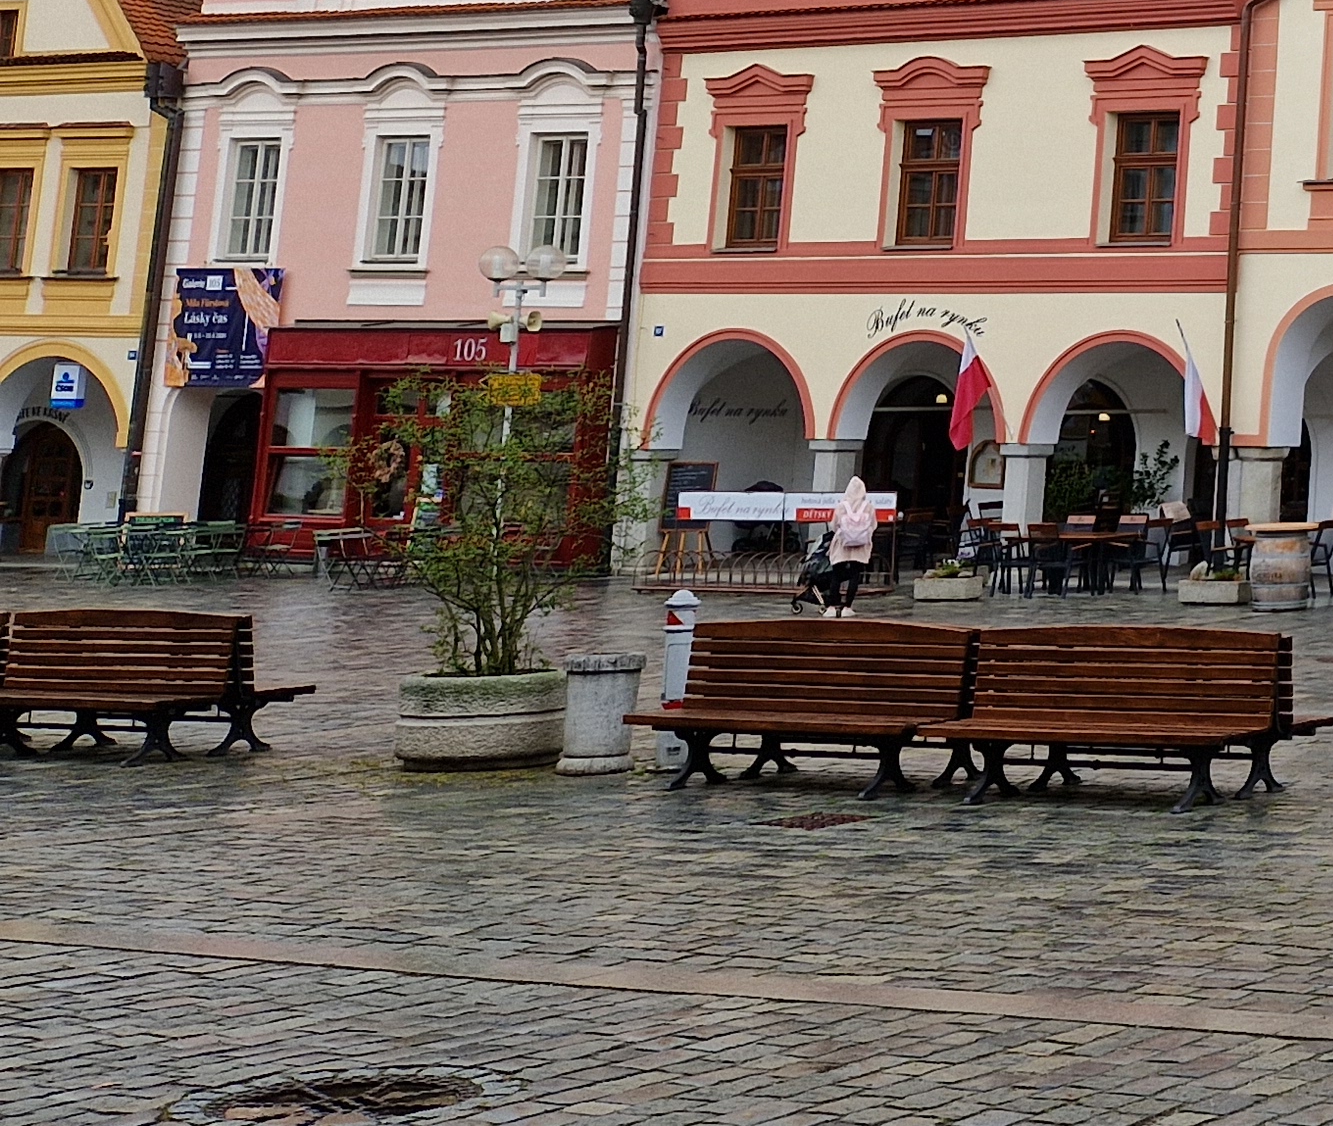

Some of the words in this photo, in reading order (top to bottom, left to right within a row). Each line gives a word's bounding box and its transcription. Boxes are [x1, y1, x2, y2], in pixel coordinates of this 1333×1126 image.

[184, 311, 210, 327] Lásky
[212, 312, 228, 323] čas
[866, 298, 916, 339] Bufet
[917, 305, 936, 317] na
[940, 309, 987, 338] rynku
[453, 337, 487, 361] 105
[689, 395, 723, 423] Bufet
[724, 406, 746, 417] na
[749, 399, 788, 425] rynku
[695, 496, 736, 515] Bufet
[736, 506, 750, 515] na
[752, 501, 791, 519] rynku
[803, 508, 833, 519] DĚTSKÝ
